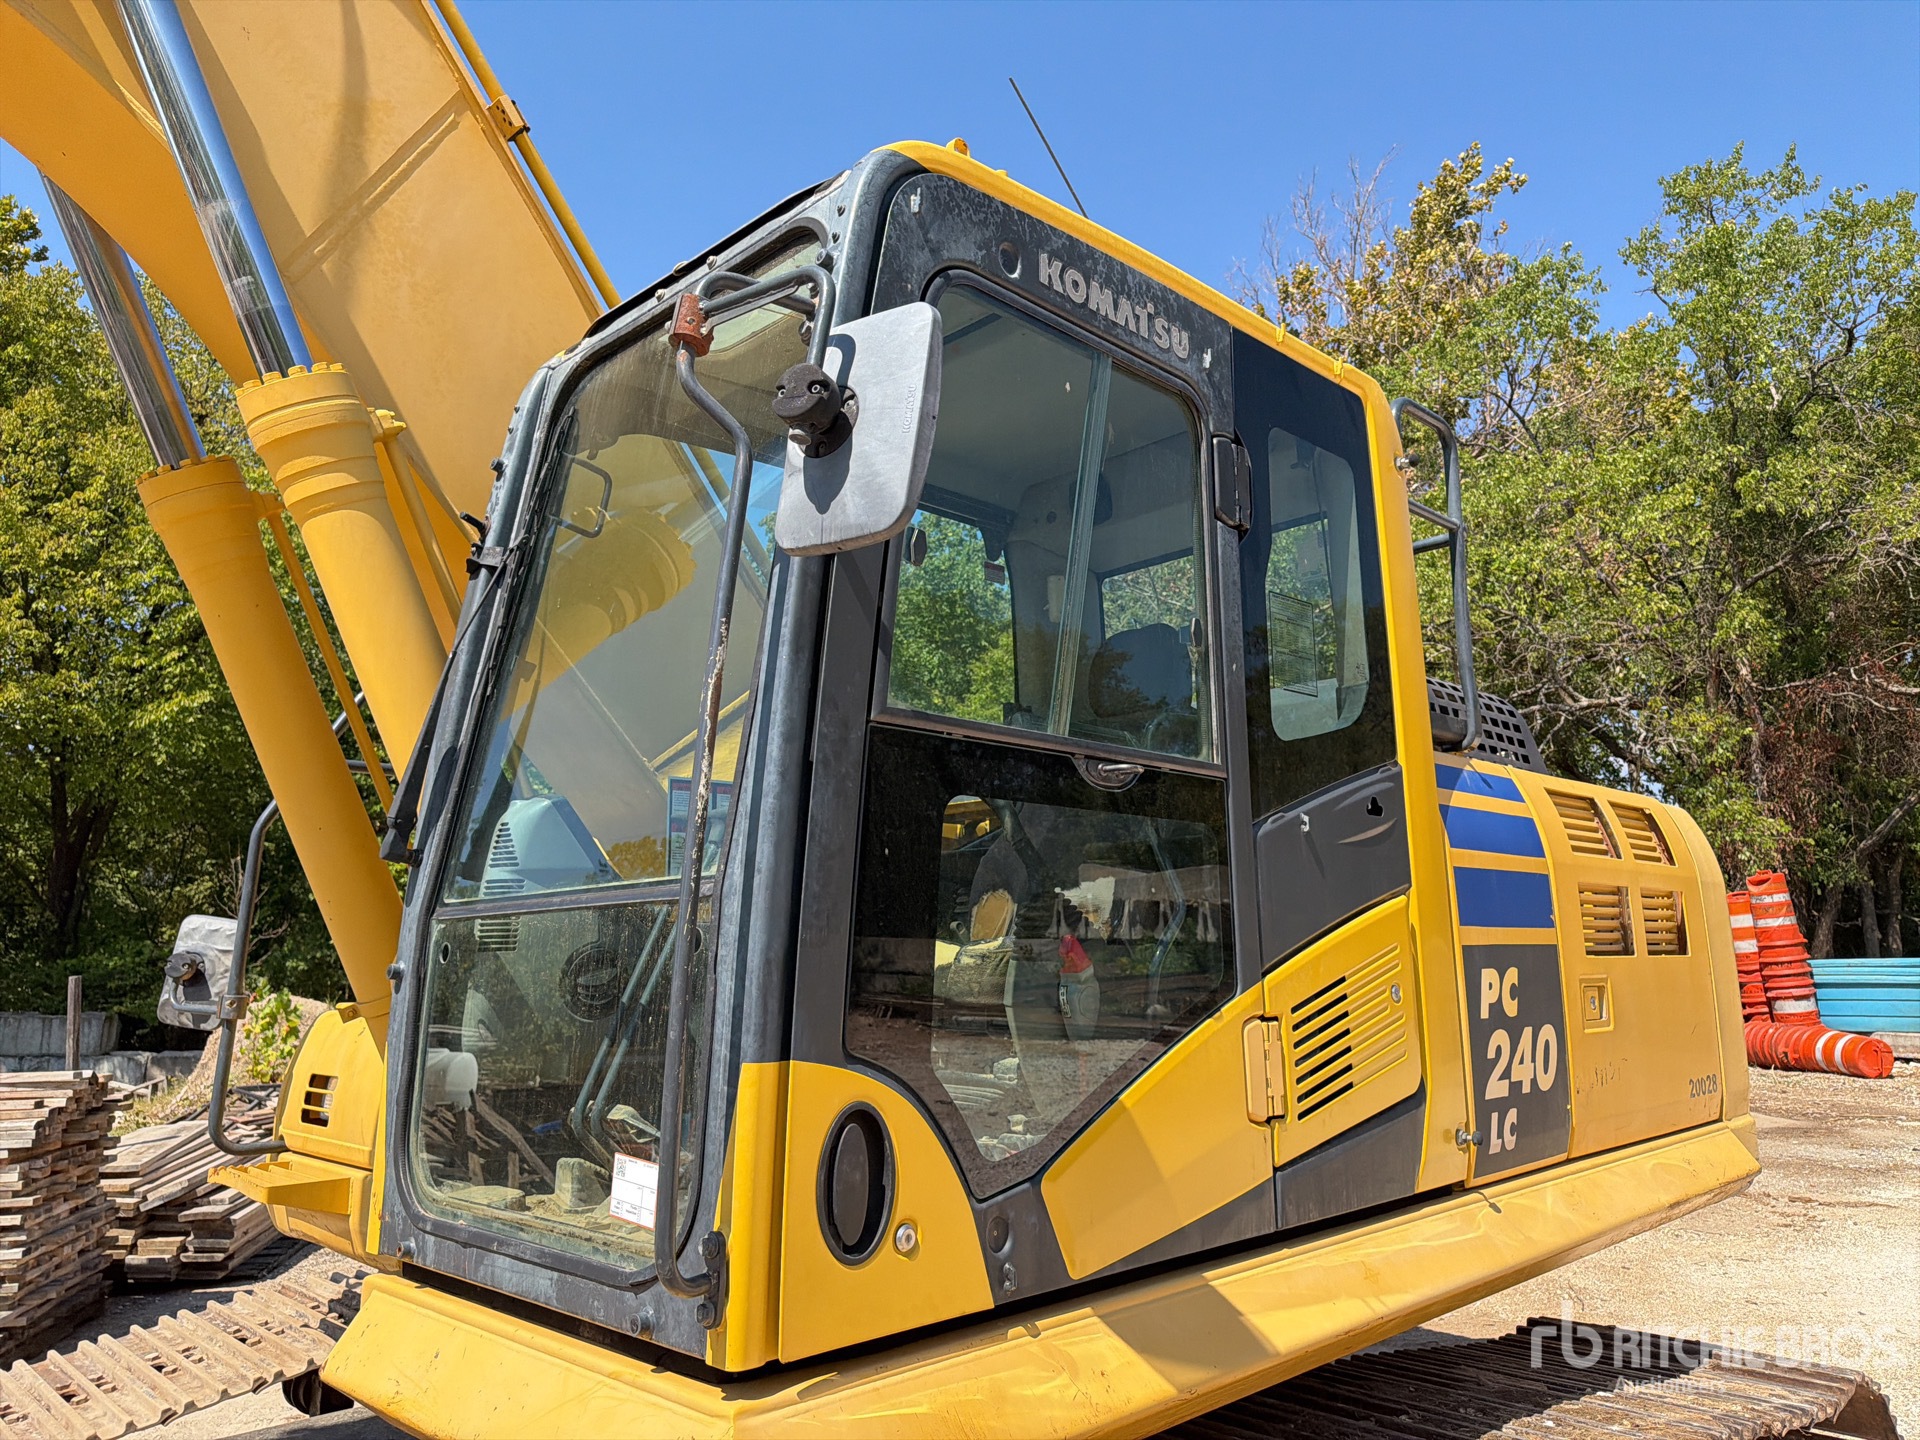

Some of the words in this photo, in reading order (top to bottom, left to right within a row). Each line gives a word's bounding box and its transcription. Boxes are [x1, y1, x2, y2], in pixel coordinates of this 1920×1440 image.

[1039, 252, 1190, 359] KOMATSU
[1480, 966, 1519, 1019] PC
[1484, 1023, 1558, 1100] 240
[1688, 1073, 1718, 1098] 20028
[1488, 1107, 1518, 1155] LC
